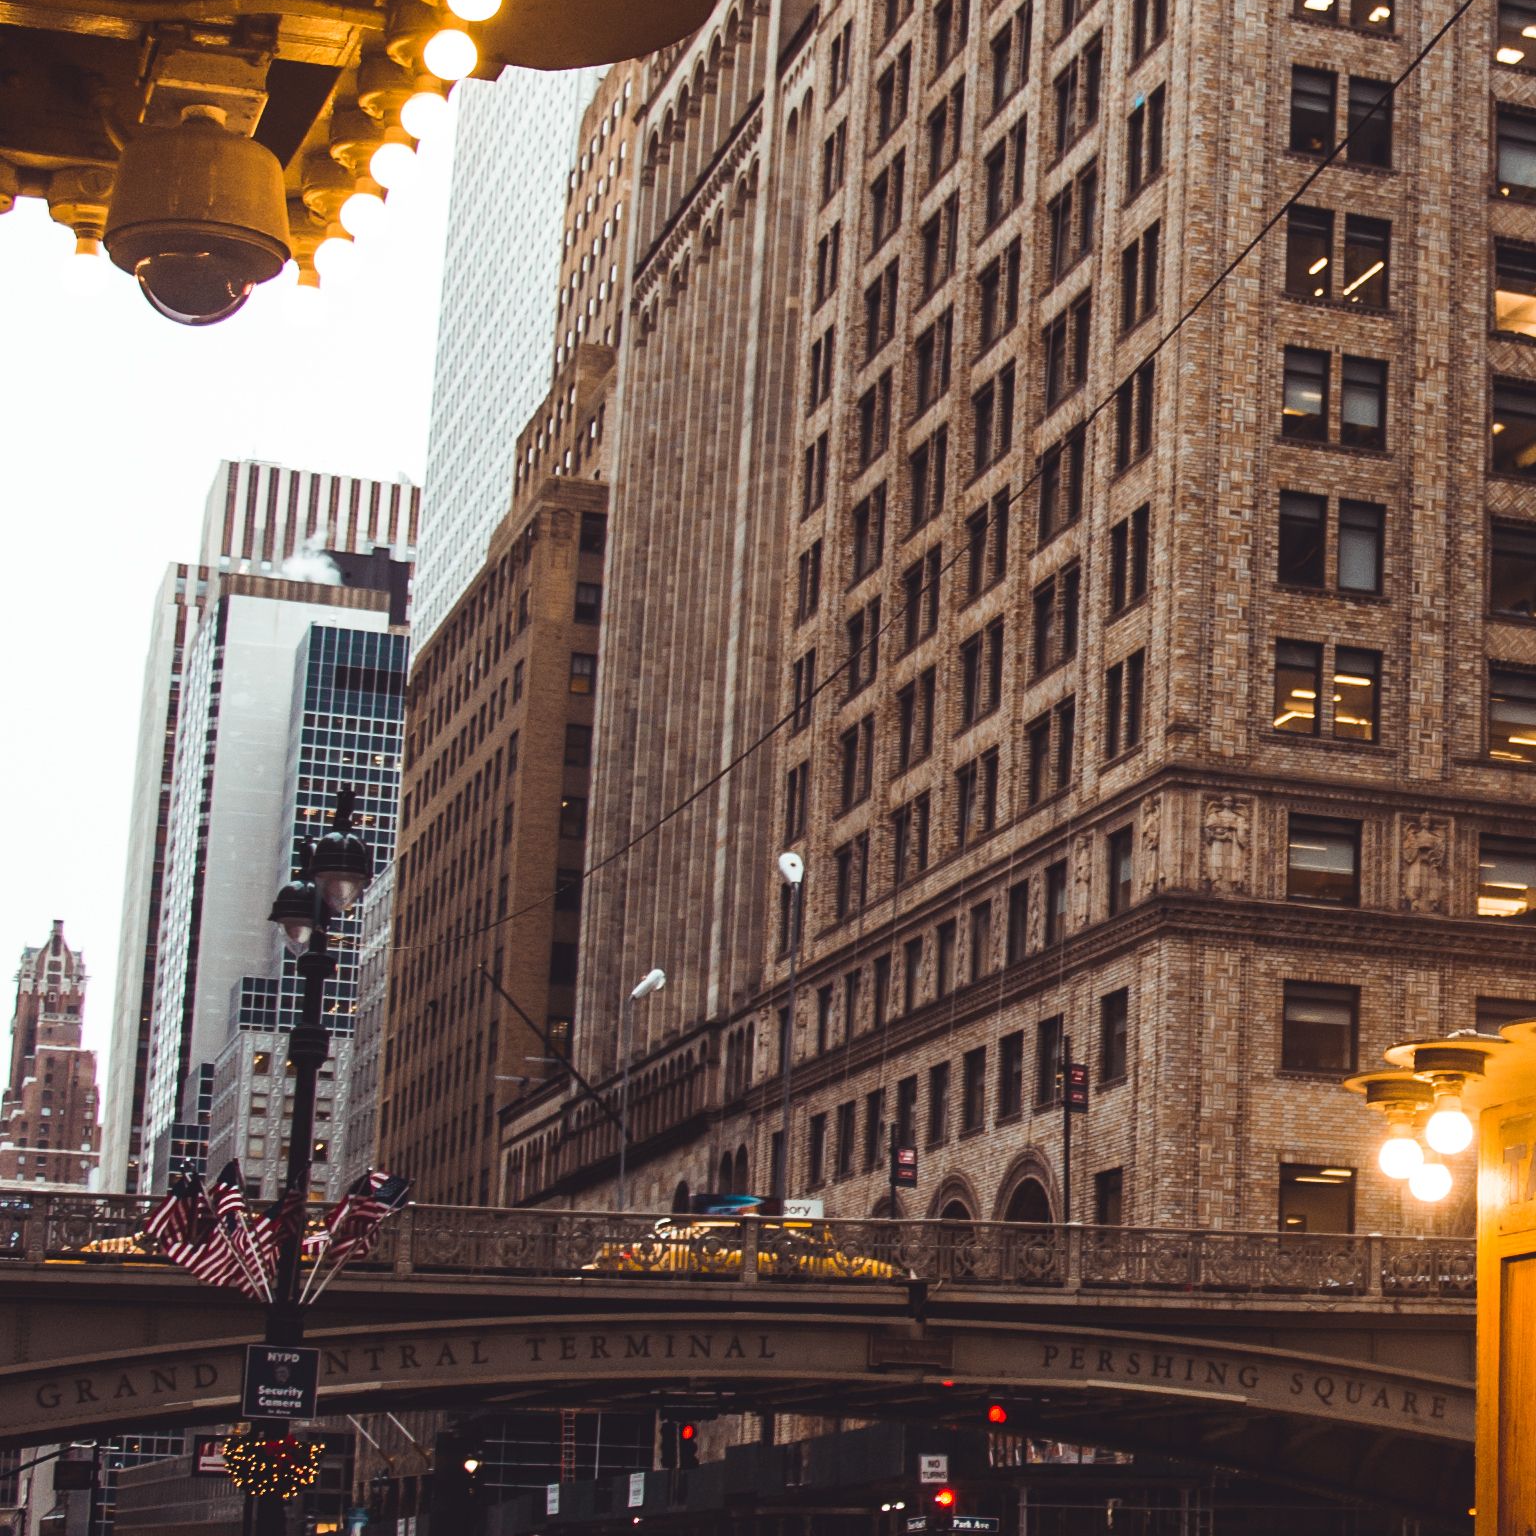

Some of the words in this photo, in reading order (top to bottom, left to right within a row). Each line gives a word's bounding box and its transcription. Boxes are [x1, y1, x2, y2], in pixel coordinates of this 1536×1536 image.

[267, 1352, 300, 1363] NYPD
[35, 1363, 219, 1409] GRAND
[324, 1340, 490, 1375] NTRAL
[526, 1334, 776, 1363] TERMINAL
[1043, 1345, 1260, 1389] PERSHING
[1290, 1373, 1448, 1419] SQUARE
[258, 1385, 304, 1399] Security
[258, 1396, 302, 1408] Camera
[927, 1459, 940, 1469] NO
[922, 1471, 947, 1480] TURNS
[952, 1519, 972, 1529] Park
[973, 1520, 990, 1530] Ave
